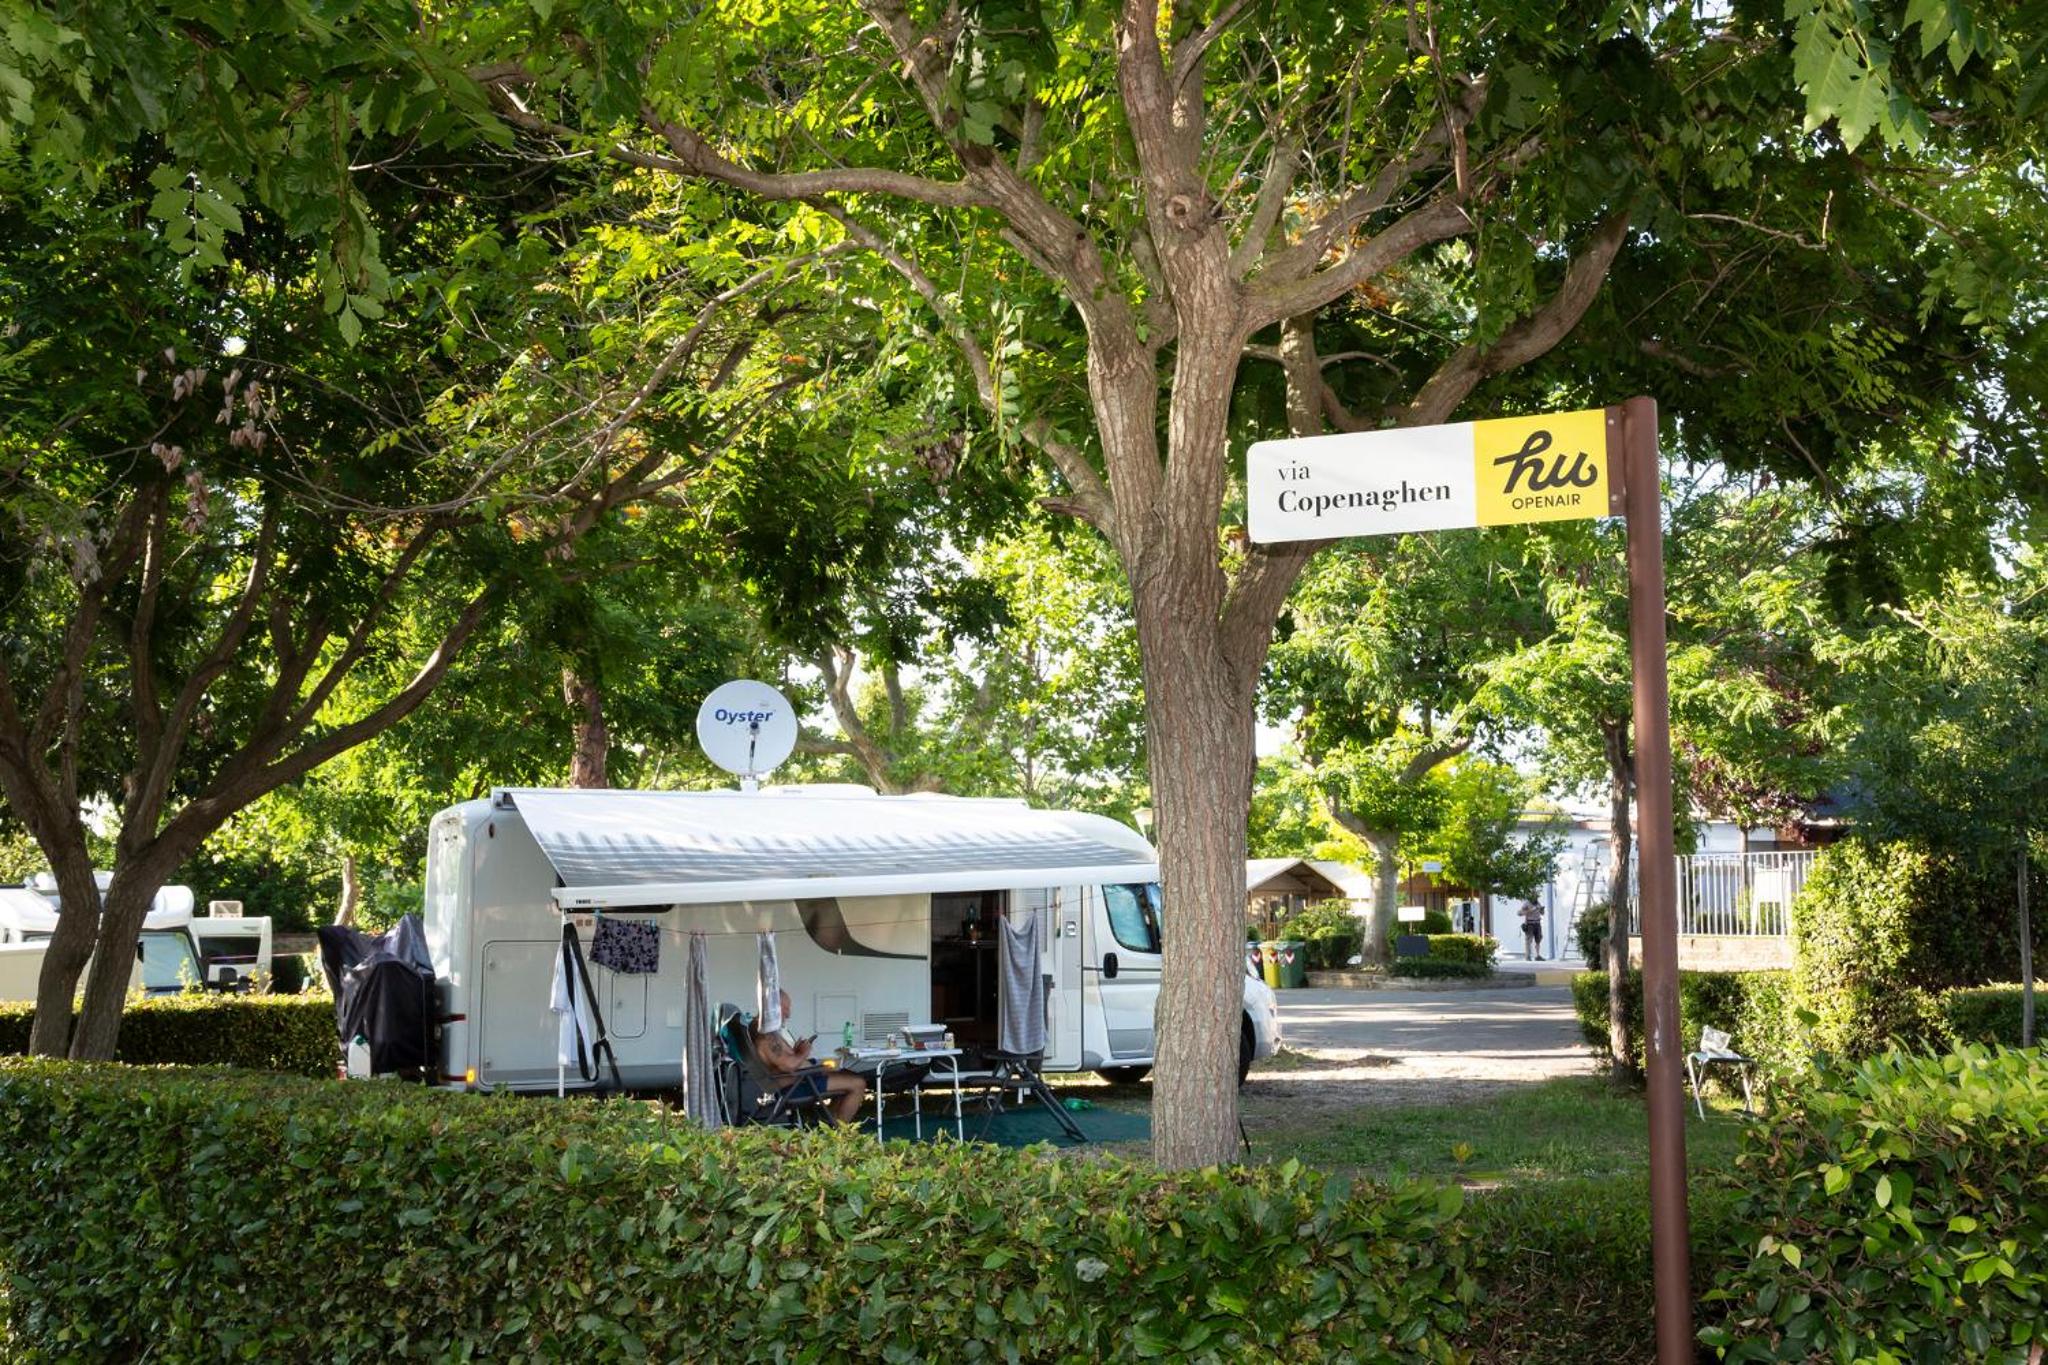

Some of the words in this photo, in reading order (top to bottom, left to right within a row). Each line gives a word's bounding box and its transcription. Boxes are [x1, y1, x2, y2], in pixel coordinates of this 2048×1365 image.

[1278, 460, 1310, 480] via
[1493, 430, 1598, 494] hu
[1278, 481, 1451, 517] Copenaghen
[1511, 494, 1581, 511] OPENAIR
[716, 709, 773, 725] Oyster
